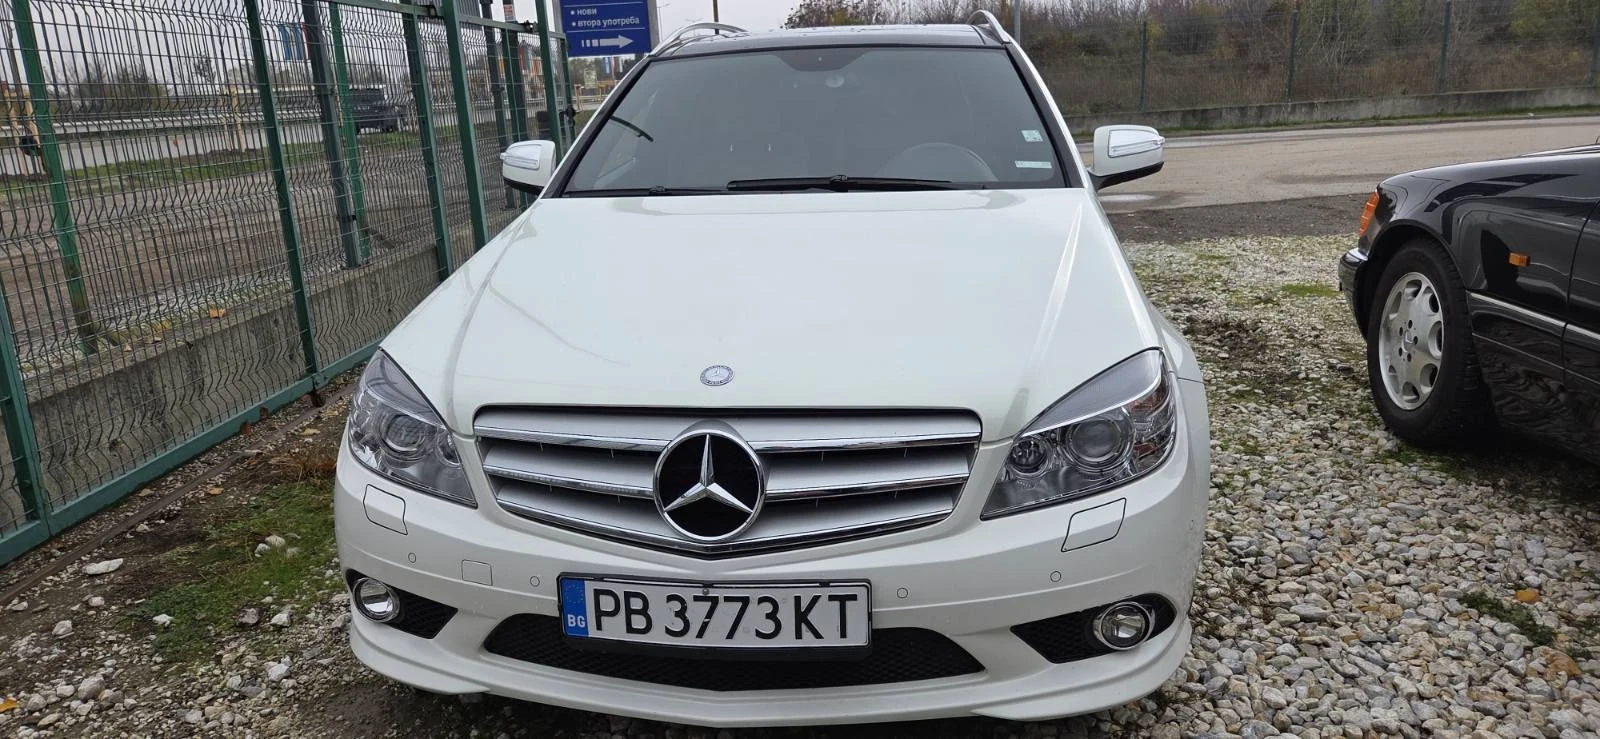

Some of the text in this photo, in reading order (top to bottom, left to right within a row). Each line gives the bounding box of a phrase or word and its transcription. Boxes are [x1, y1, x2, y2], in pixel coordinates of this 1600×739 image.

[577, 8, 597, 16] нови
[578, 17, 640, 28] втора употреба
[593, 588, 858, 641] PB 3773 KT
[567, 614, 586, 628] BG
